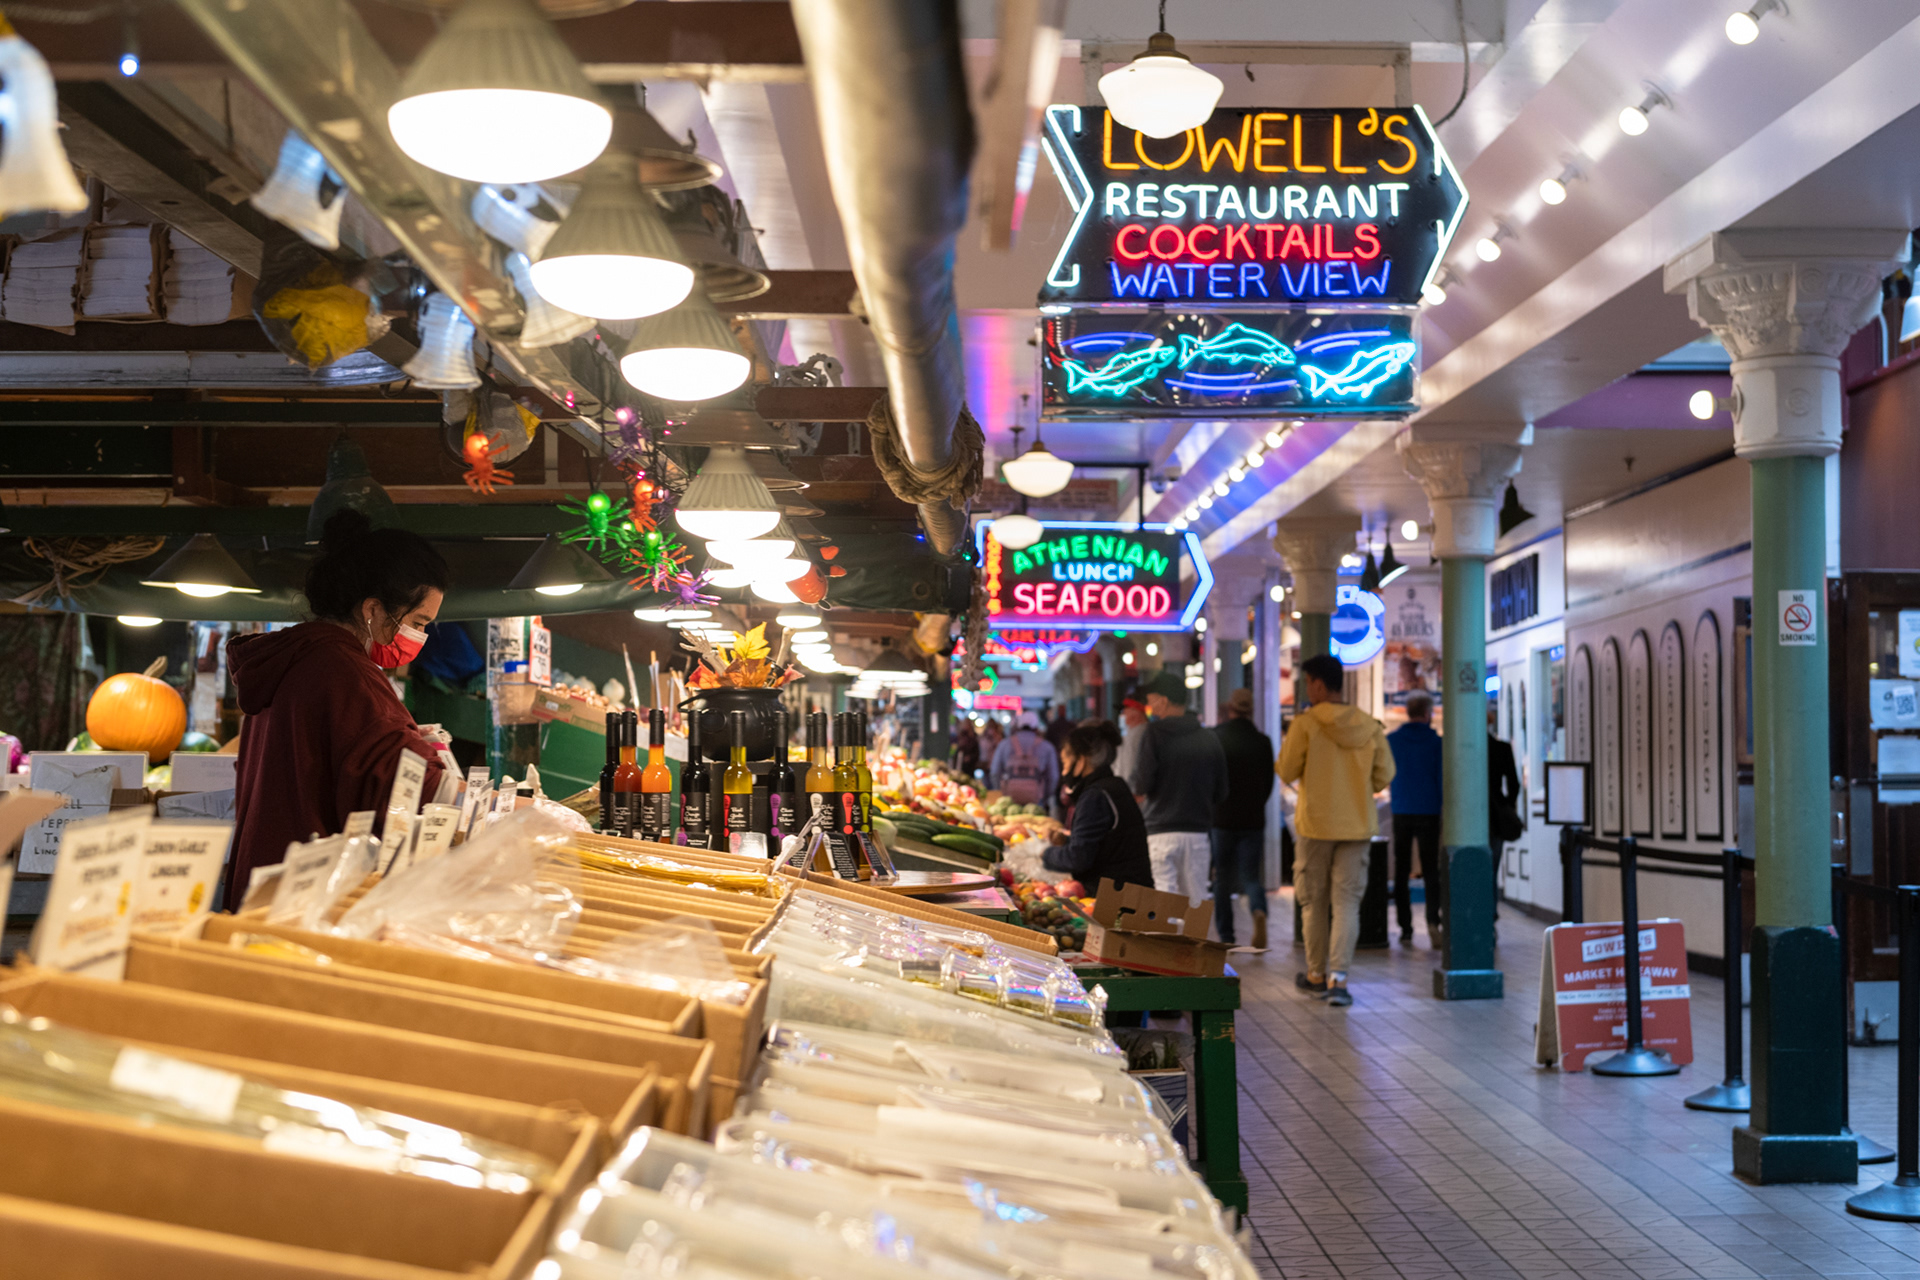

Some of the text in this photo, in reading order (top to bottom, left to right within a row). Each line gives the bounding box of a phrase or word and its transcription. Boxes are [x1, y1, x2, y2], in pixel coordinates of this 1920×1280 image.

[1102, 107, 1418, 175] LOWELL'S
[1104, 181, 1410, 220] RESTAURANT
[1115, 223, 1382, 260] COCKTAILS
[1110, 260, 1392, 298] WATER VIEW
[1012, 534, 1170, 577] ATHENIAN
[1052, 562, 1135, 583] LUNCH
[1013, 582, 1172, 619] SEAFOOD
[1781, 634, 1816, 642] SMOKING
[1586, 934, 1652, 956] LOWE'S
[1564, 965, 1678, 984] MARKET HEAWAY
